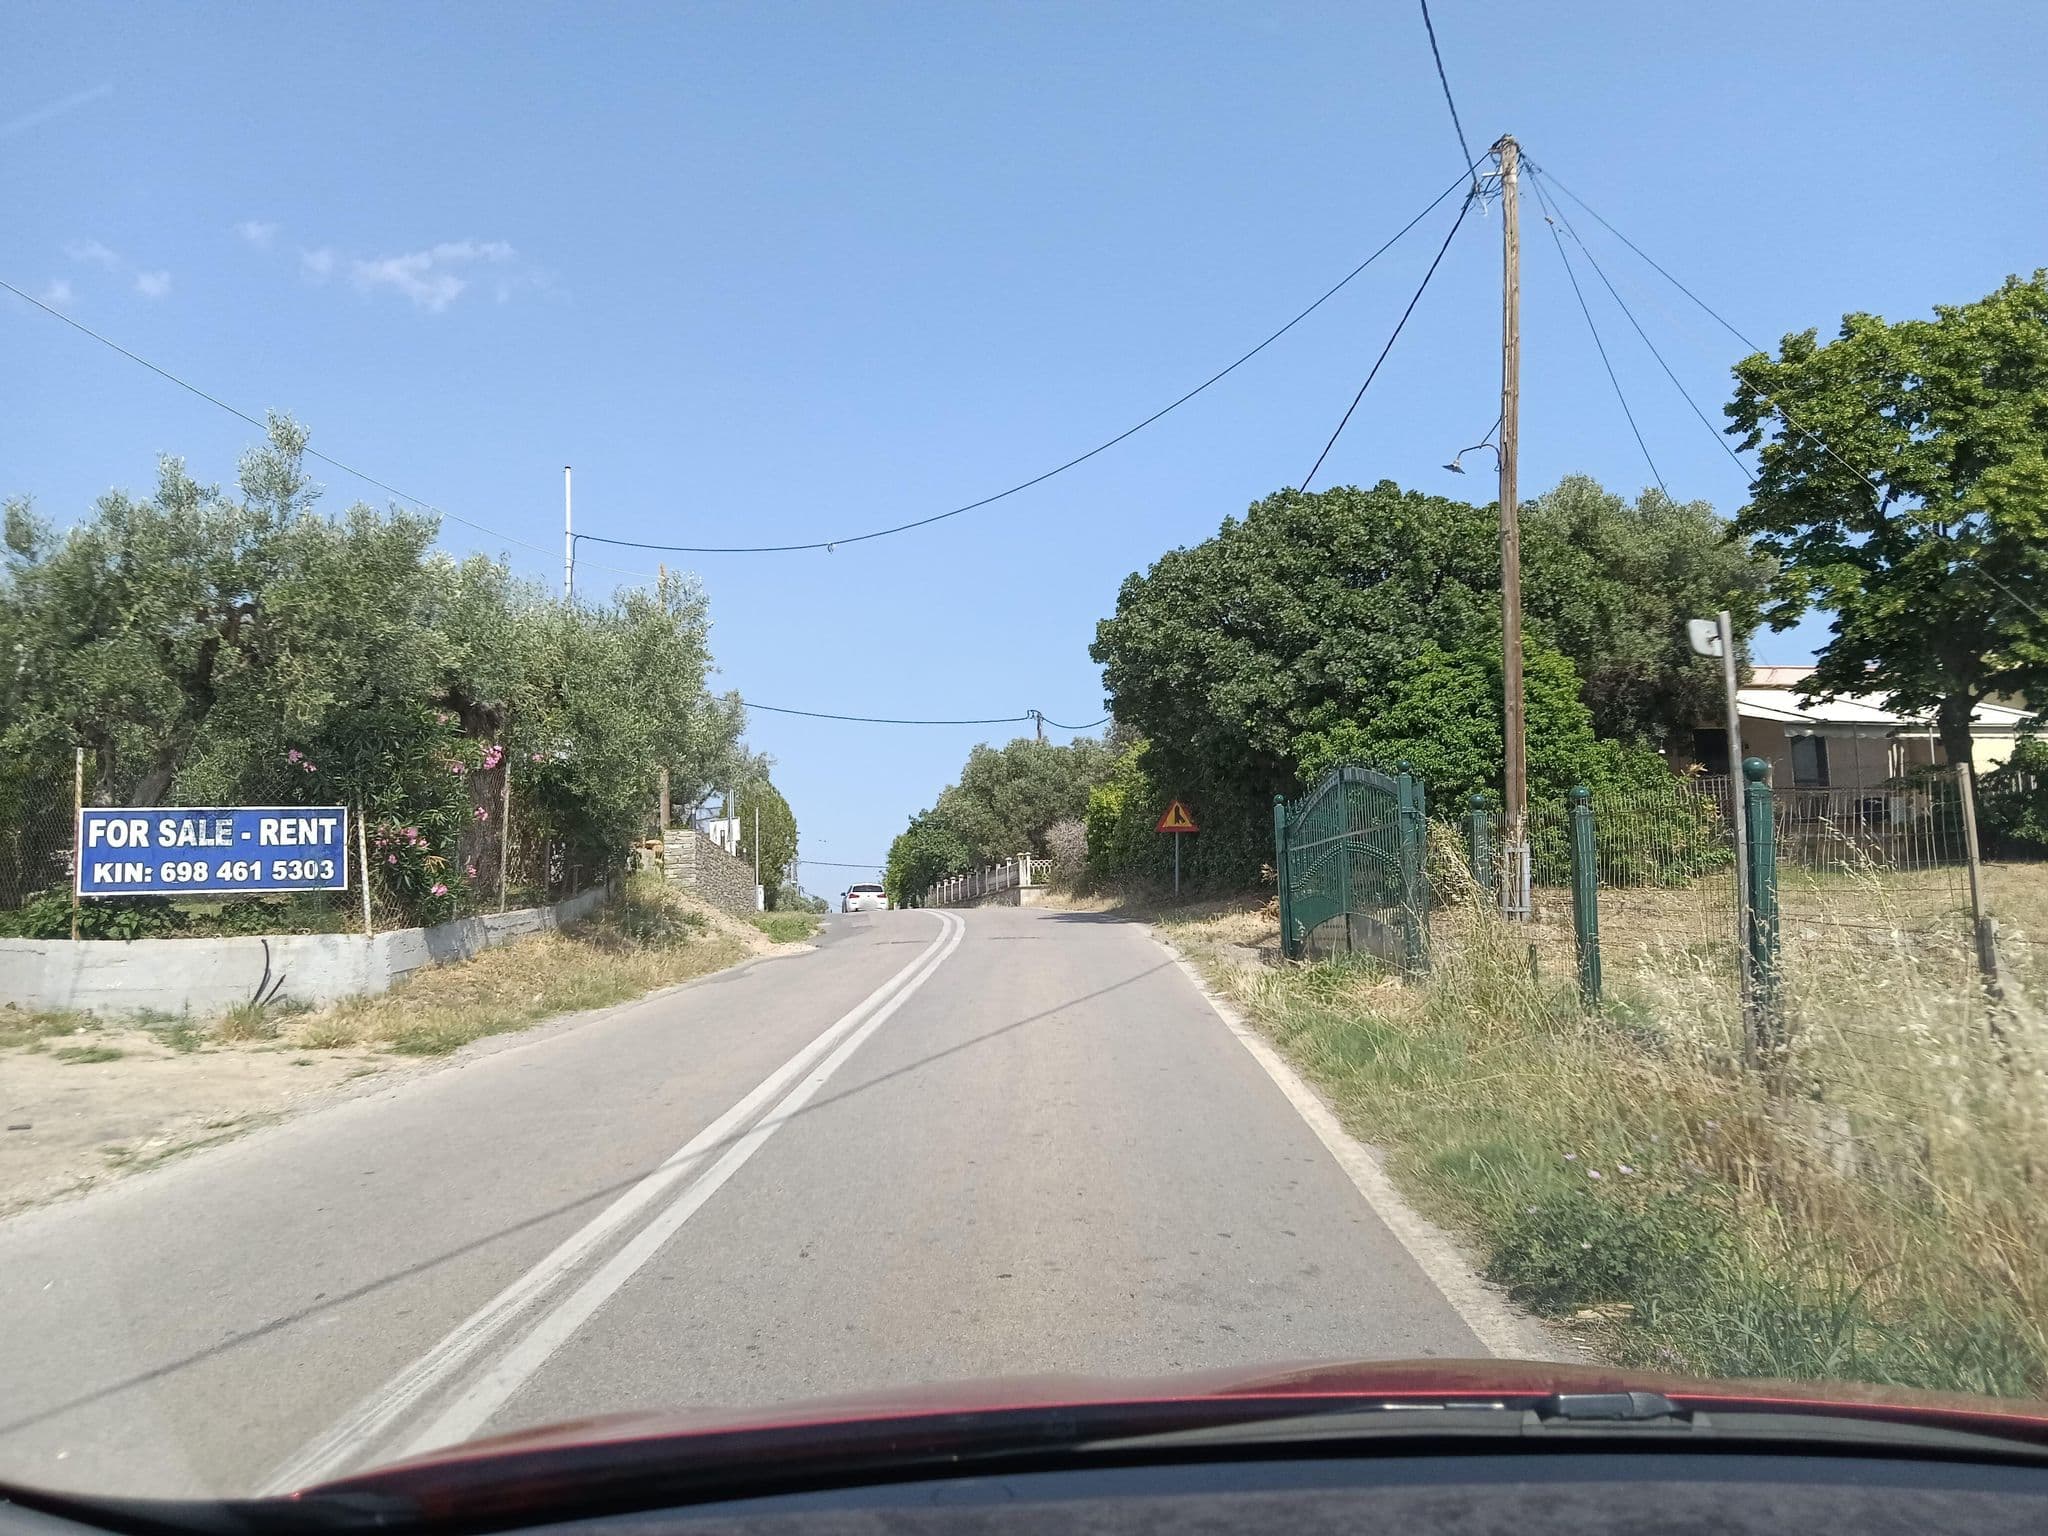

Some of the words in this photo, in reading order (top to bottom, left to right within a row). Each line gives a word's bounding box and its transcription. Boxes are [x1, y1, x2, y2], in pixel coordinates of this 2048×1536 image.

[88, 818, 149, 848] FOR
[158, 817, 233, 847] SALE
[259, 817, 337, 846] RENT
[93, 862, 153, 884] KIN:
[160, 861, 209, 883] 698
[216, 860, 262, 881] 461
[272, 859, 335, 881] 5303
